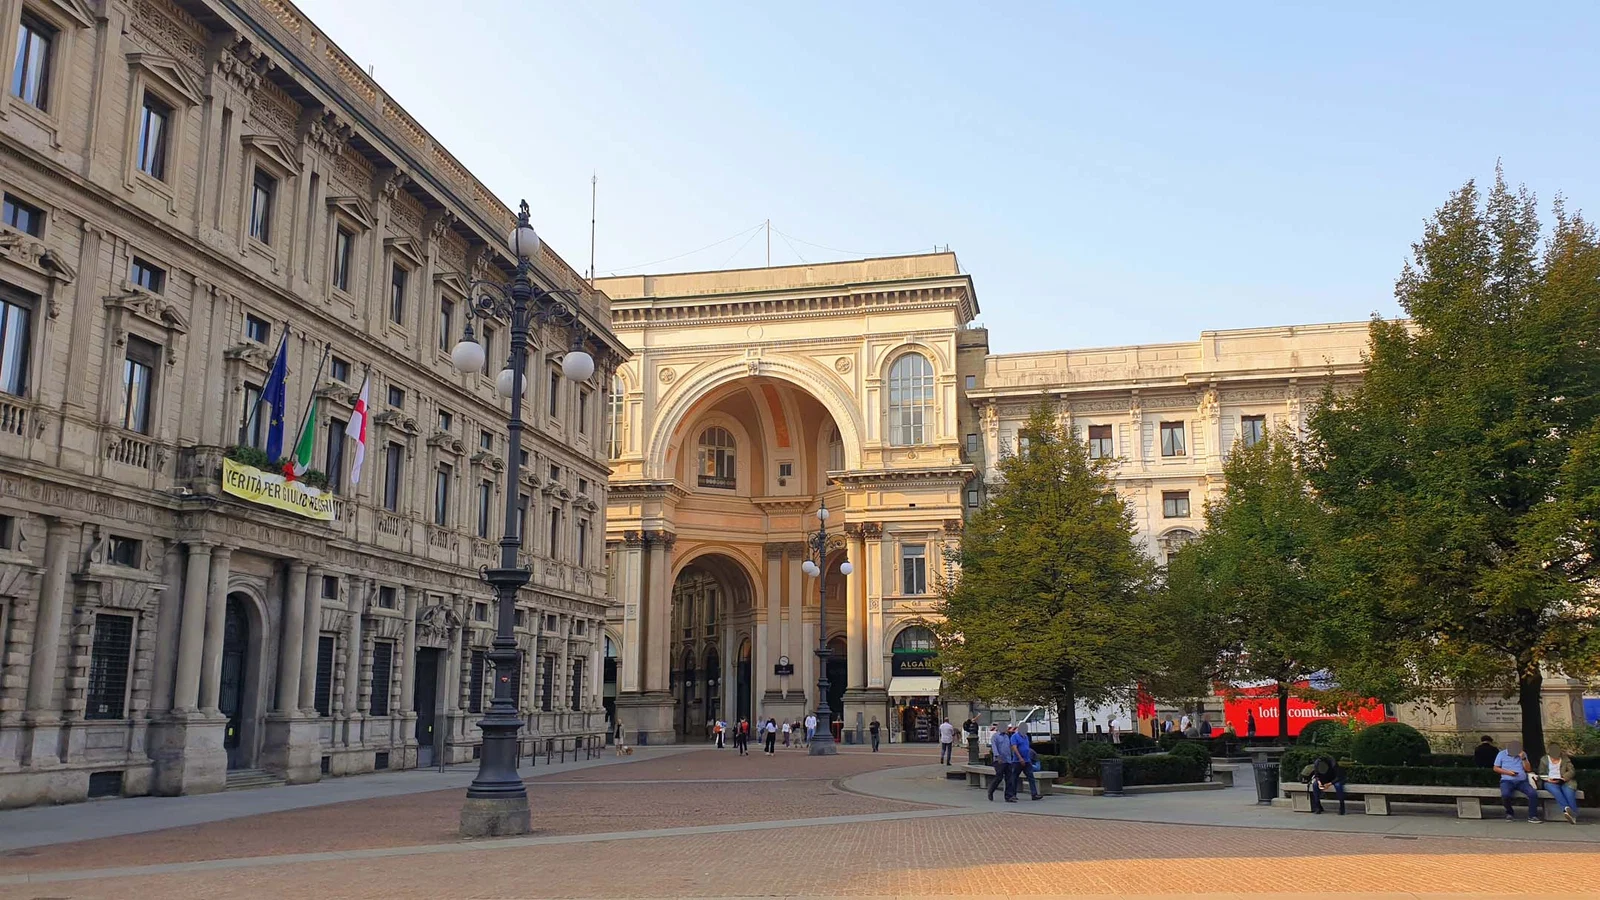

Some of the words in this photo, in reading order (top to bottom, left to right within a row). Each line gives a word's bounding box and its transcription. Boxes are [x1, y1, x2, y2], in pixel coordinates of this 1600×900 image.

[225, 468, 262, 495] VERITÀ
[261, 481, 281, 499] PER
[282, 486, 308, 508] GIULIO
[1259, 706, 1280, 718] lott
